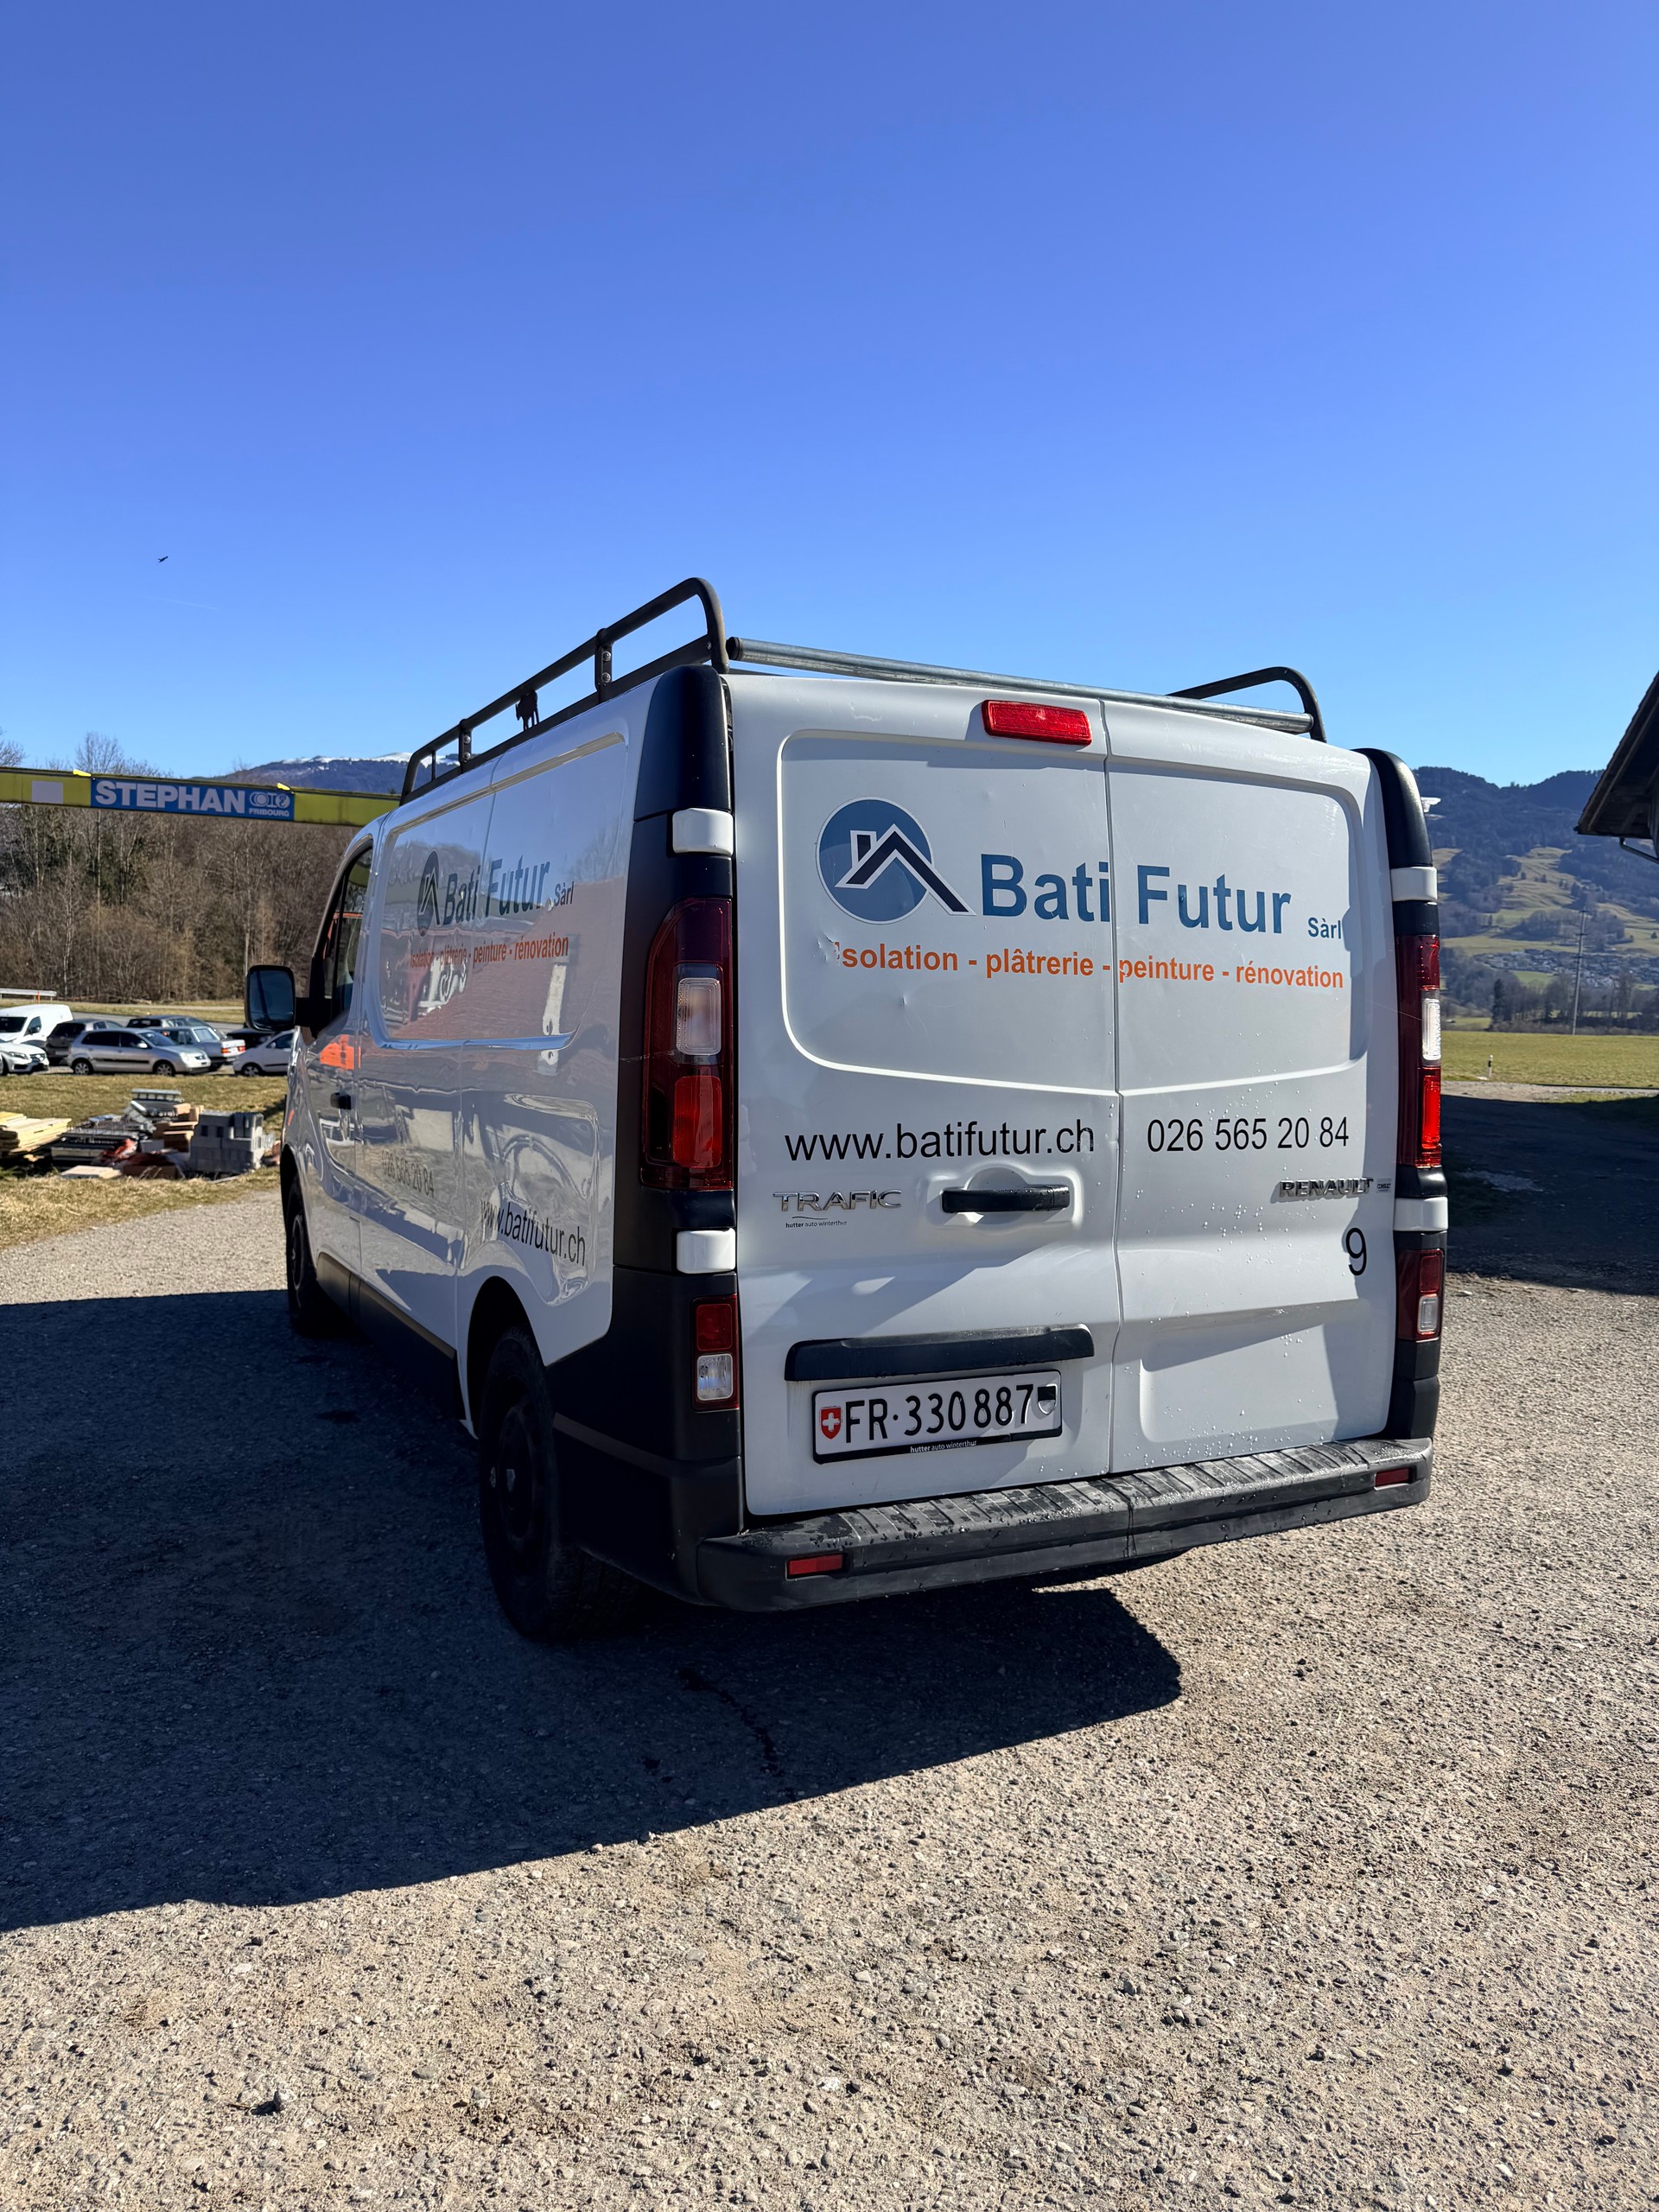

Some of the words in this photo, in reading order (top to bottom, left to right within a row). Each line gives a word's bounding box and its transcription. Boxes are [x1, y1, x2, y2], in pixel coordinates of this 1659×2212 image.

[95, 780, 245, 814] STEPHAN
[249, 807, 289, 817] FRIBOURG
[443, 865, 480, 925] Bati
[485, 855, 550, 918] Futur
[554, 880, 575, 907] Sàrl
[981, 853, 1110, 922] Bati
[1137, 865, 1292, 934] Futur
[1307, 917, 1342, 939] Sàrl
[473, 940, 506, 969] peinture
[513, 931, 569, 961] rénovation
[986, 948, 1094, 978] plâtrerie
[1119, 955, 1214, 983] peinture
[1236, 961, 1344, 988] rénovation
[785, 1119, 1095, 1161] www.batifutur.ch
[1147, 1119, 1204, 1152] 026
[1215, 1118, 1268, 1151] 565
[1277, 1117, 1310, 1148] 20
[1319, 1116, 1349, 1147] 84
[773, 1188, 902, 1211] TRAFIC
[1279, 1178, 1373, 1198] RENAULT
[480, 1198, 586, 1267] www.batifutur.ch
[1345, 1227, 1367, 1275] 9
